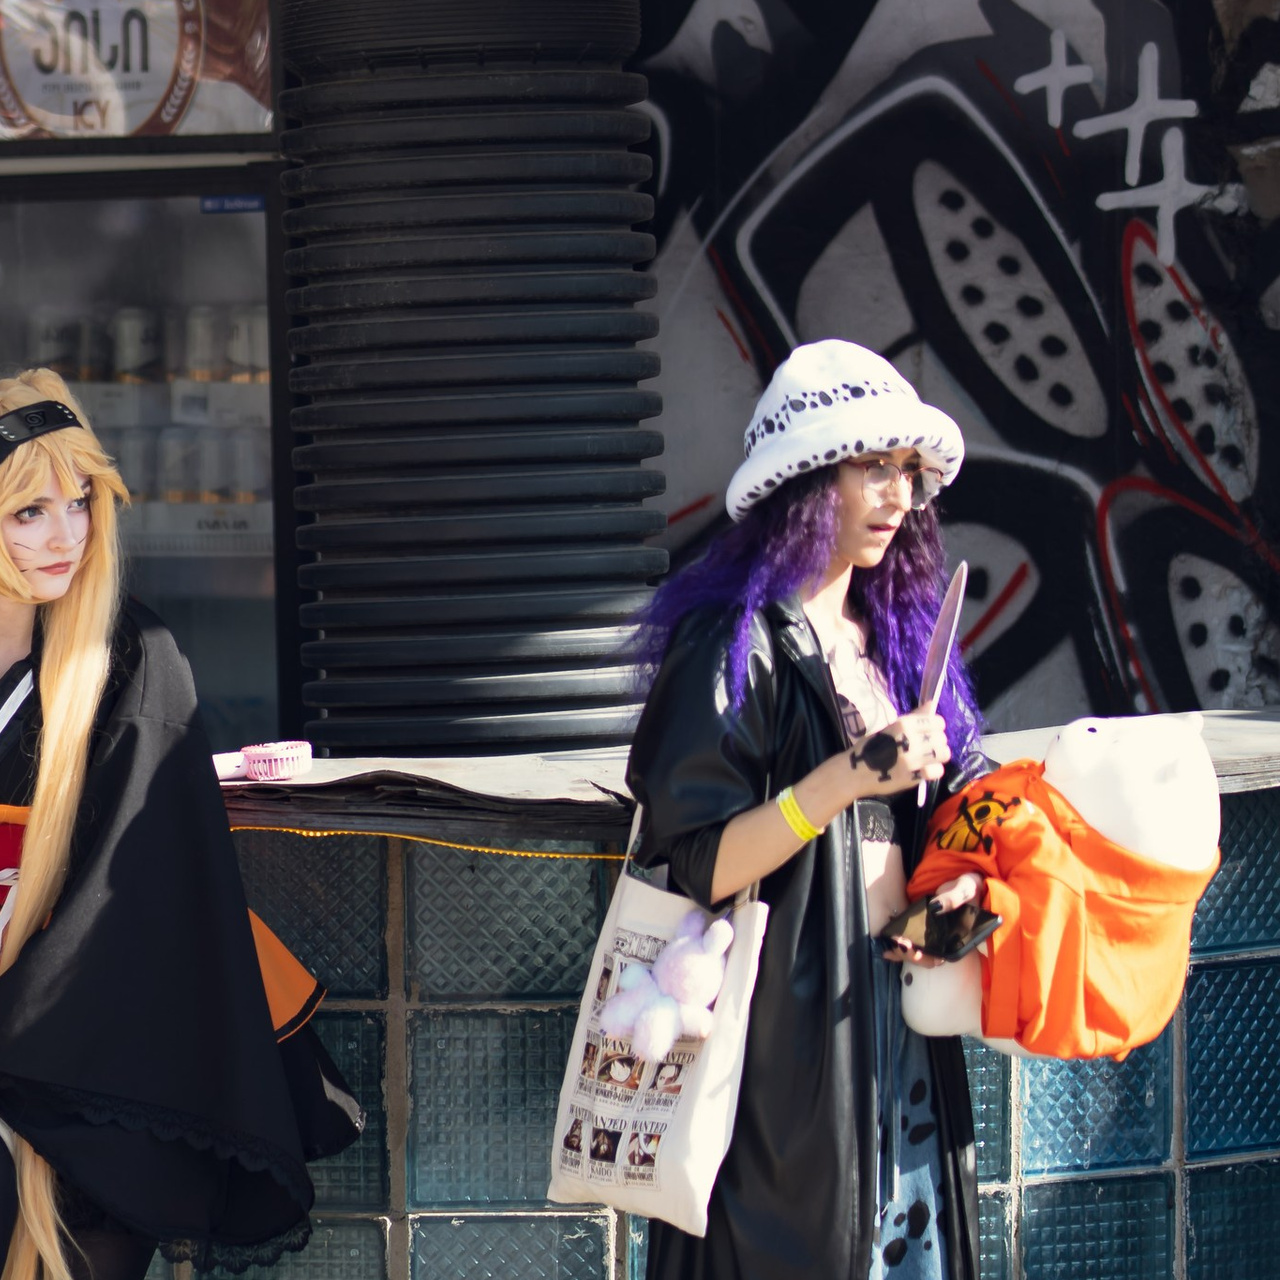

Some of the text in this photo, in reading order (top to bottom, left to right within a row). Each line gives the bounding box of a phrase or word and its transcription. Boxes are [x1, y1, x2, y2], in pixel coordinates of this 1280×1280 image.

[72, 99, 111, 131] ICY
[663, 1051, 695, 1065] ANTED
[592, 1114, 627, 1131] ANTED
[631, 1120, 668, 1133] WANTED
[591, 1166, 613, 1177] KAIDO
